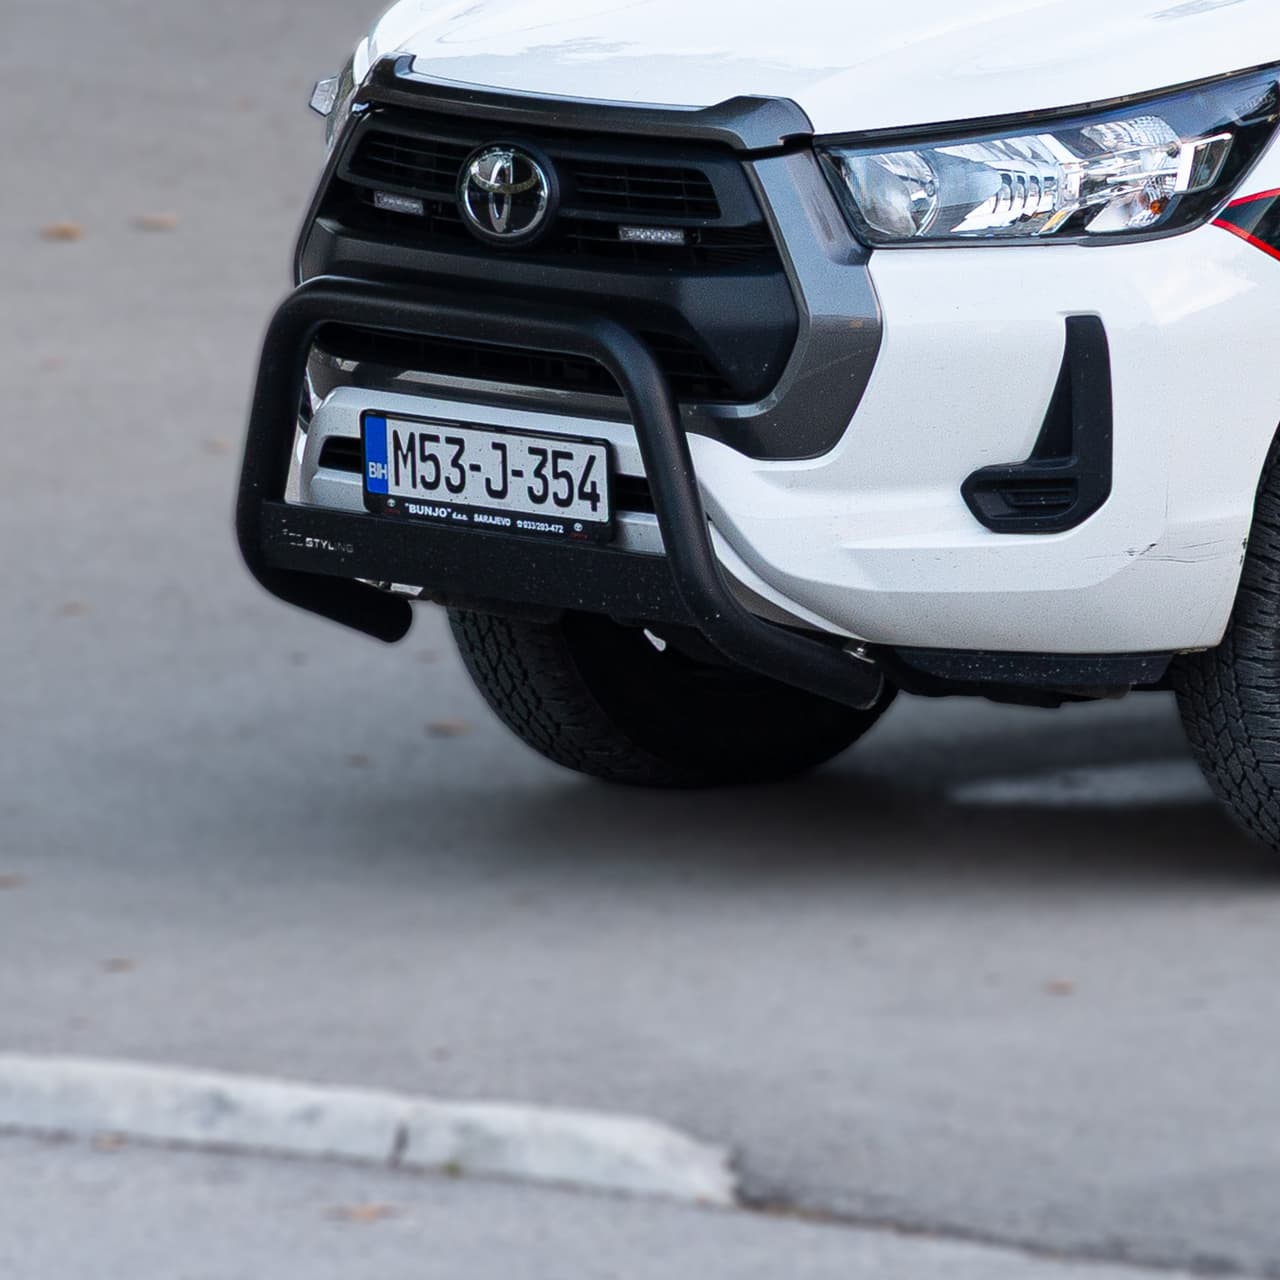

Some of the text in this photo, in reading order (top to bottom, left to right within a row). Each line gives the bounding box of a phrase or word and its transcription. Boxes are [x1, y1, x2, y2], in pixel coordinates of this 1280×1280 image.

[368, 461, 387, 480] BIH
[392, 429, 600, 513] M53-J-354
[473, 513, 511, 527] SARAJEVO
